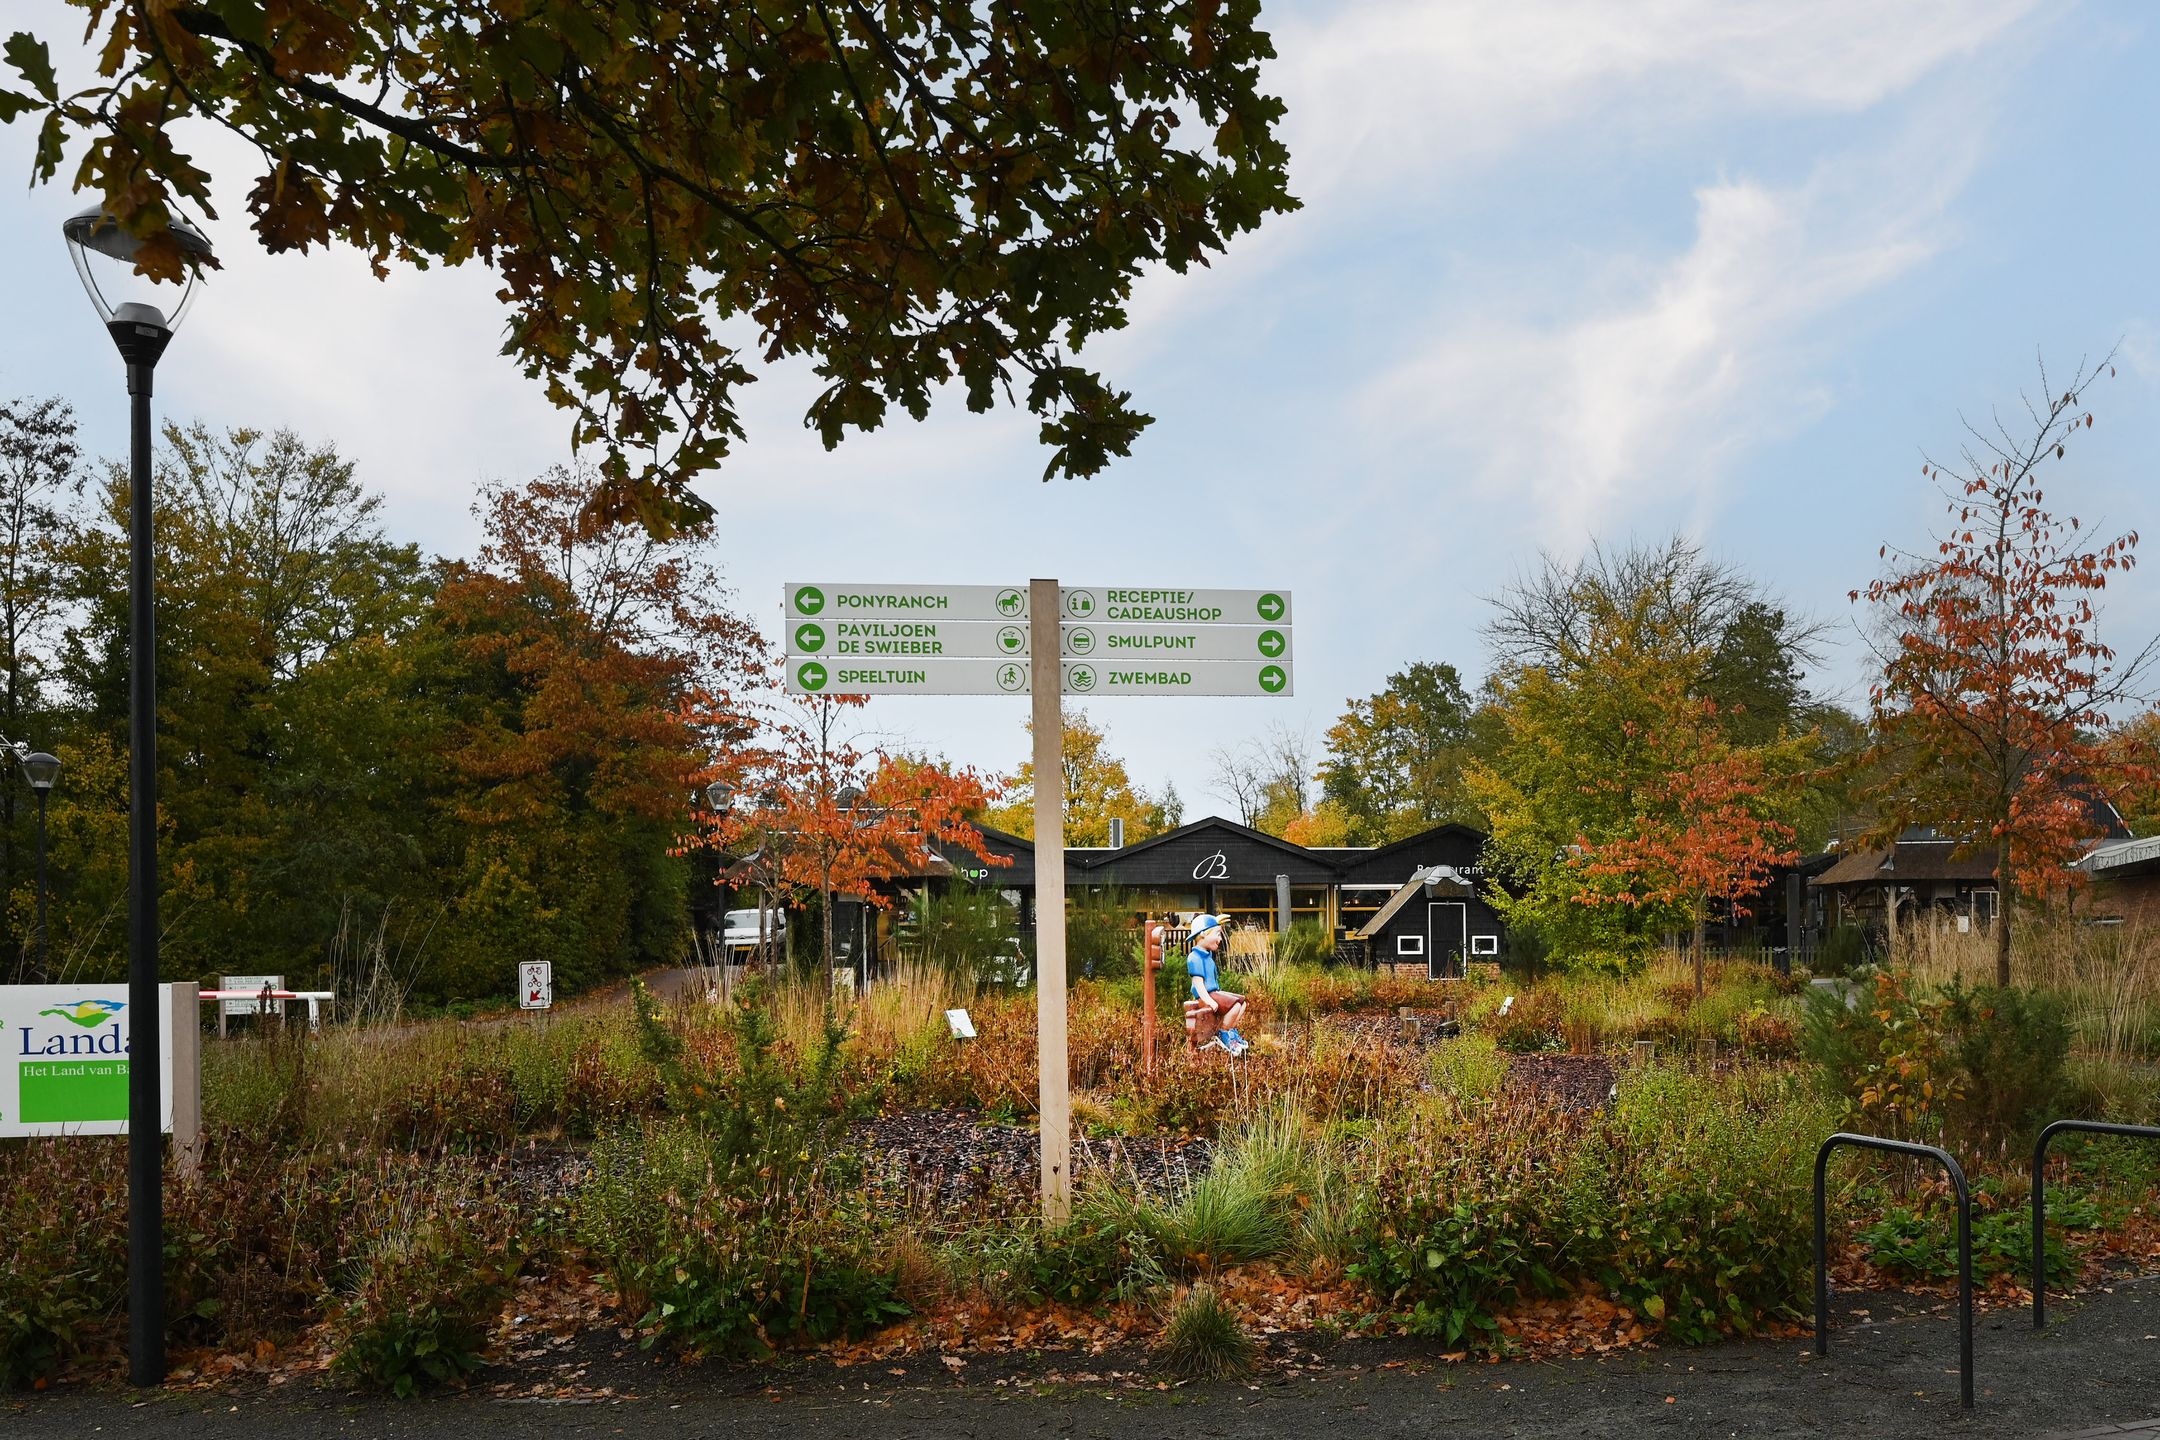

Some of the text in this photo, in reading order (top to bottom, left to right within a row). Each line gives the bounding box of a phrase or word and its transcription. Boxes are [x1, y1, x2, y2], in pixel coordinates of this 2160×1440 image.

[837, 594, 949, 609] PONYRANCH
[1107, 590, 1193, 605] RECEPTIE/
[1107, 606, 1222, 621] CADEAUSHOP
[837, 624, 937, 638] PAVILJOEN
[838, 640, 943, 655] DE SWIEBER
[1107, 635, 1196, 649] SMULPUNT
[838, 669, 926, 685] SPEELTUIN
[1108, 671, 1192, 686] ZWEMBAD
[1192, 849, 1231, 880] B
[24, 1066, 48, 1076] Het
[51, 1064, 85, 1076] Land
[89, 1066, 112, 1076] van
